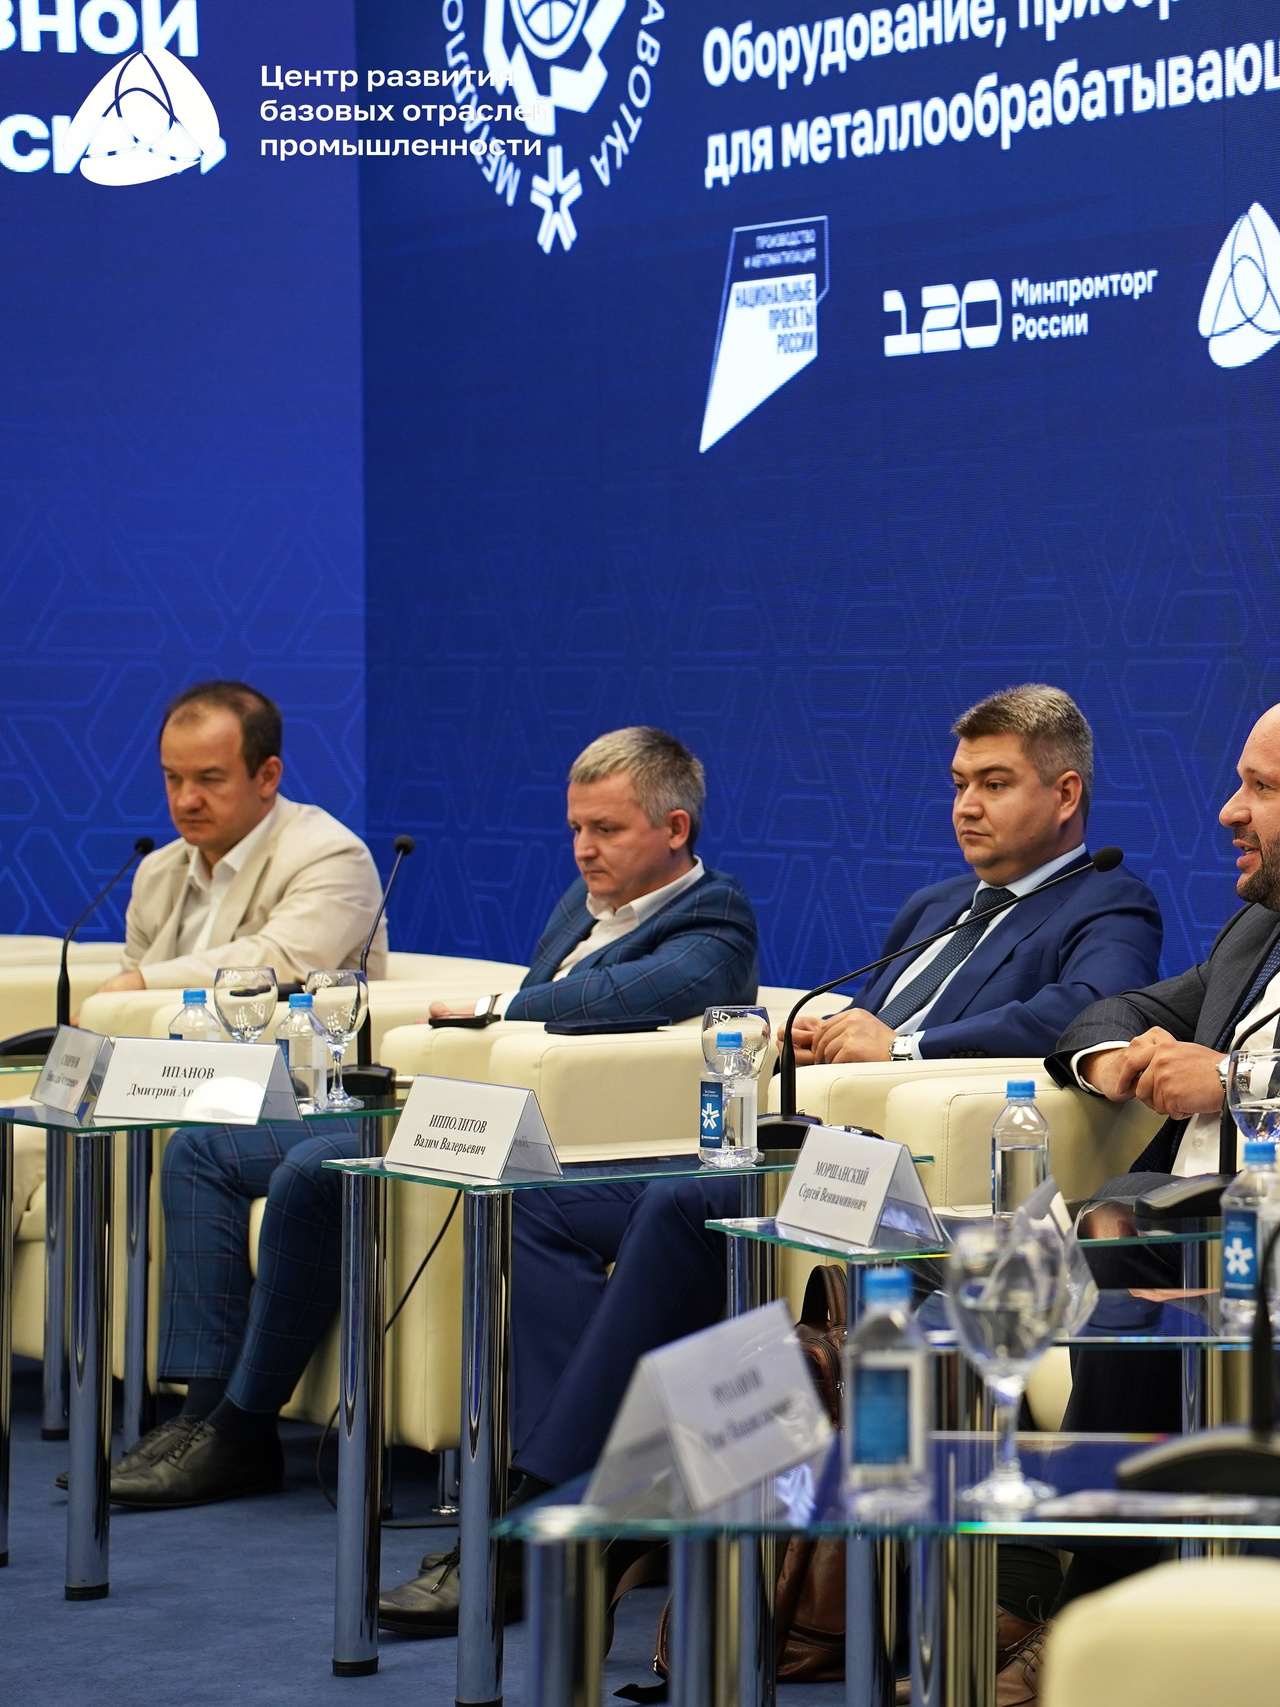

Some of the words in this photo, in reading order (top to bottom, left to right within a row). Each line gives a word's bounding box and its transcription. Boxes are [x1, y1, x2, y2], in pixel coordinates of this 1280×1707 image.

[704, 127, 775, 189] для
[1010, 268, 1158, 308] Минпромторг
[1010, 311, 1089, 342] России
[161, 1065, 215, 1080] ИПАНОВ
[126, 1083, 177, 1100] Дмитрий
[428, 1114, 488, 1134] ИППОЛИТОВ
[413, 1133, 440, 1149] Вадим
[440, 1137, 487, 1156] Валерьевич
